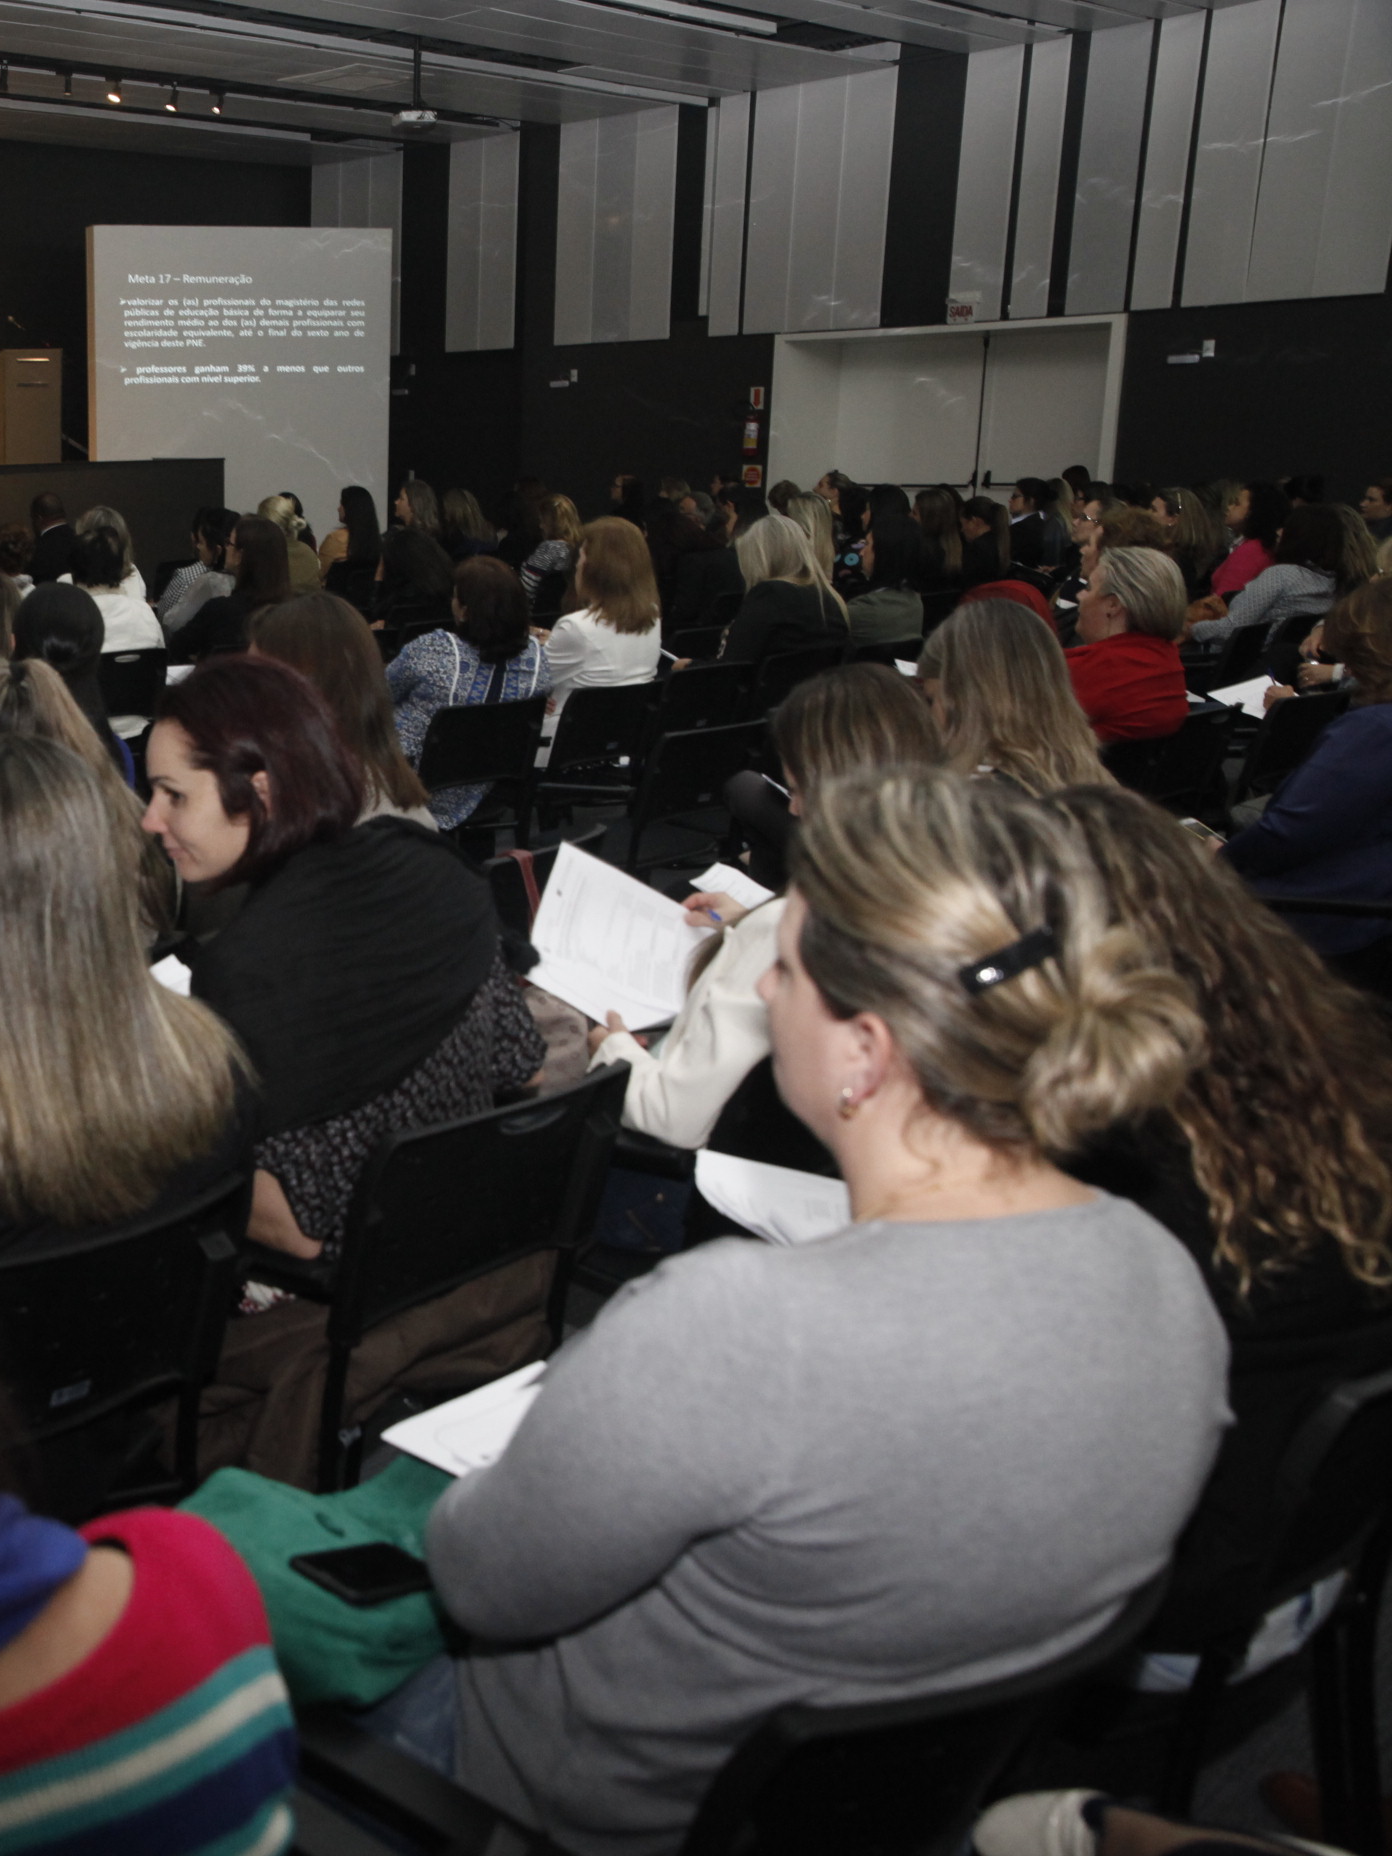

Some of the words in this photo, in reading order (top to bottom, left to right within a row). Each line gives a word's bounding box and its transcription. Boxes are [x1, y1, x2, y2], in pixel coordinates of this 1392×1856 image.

[128, 274, 155, 284] Meta
[159, 274, 171, 283] 17
[182, 274, 253, 285] Remuneração
[183, 297, 199, 307] (as)
[203, 297, 256, 307] profissionais
[260, 298, 271, 306] do
[275, 298, 319, 307] magistério
[324, 298, 338, 306] das
[342, 298, 365, 306] redes
[124, 308, 159, 317] públicas
[163, 308, 175, 316] de
[178, 308, 219, 317] educação
[223, 308, 249, 316] básica
[253, 308, 264, 316] de
[268, 308, 293, 316] forma
[307, 308, 346, 317] equiparar
[124, 318, 174, 327] rendimento
[178, 318, 205, 326] médio
[222, 318, 237, 326] dos
[241, 318, 256, 327] (as)
[293, 319, 344, 327] profissionais
[124, 328, 178, 337] escolaridade
[183, 329, 234, 338] equivalente,
[239, 329, 253, 337] até
[268, 328, 286, 336] final
[353, 329, 365, 337] de
[124, 339, 159, 349] vigência
[161, 339, 185, 347] deste
[186, 339, 206, 347] PNE.
[136, 364, 187, 375] professores
[194, 364, 229, 374] ganham
[237, 364, 255, 373] 39%
[337, 365, 364, 373] outros
[124, 376, 180, 385] profissionais
[224, 375, 261, 384] superior.
